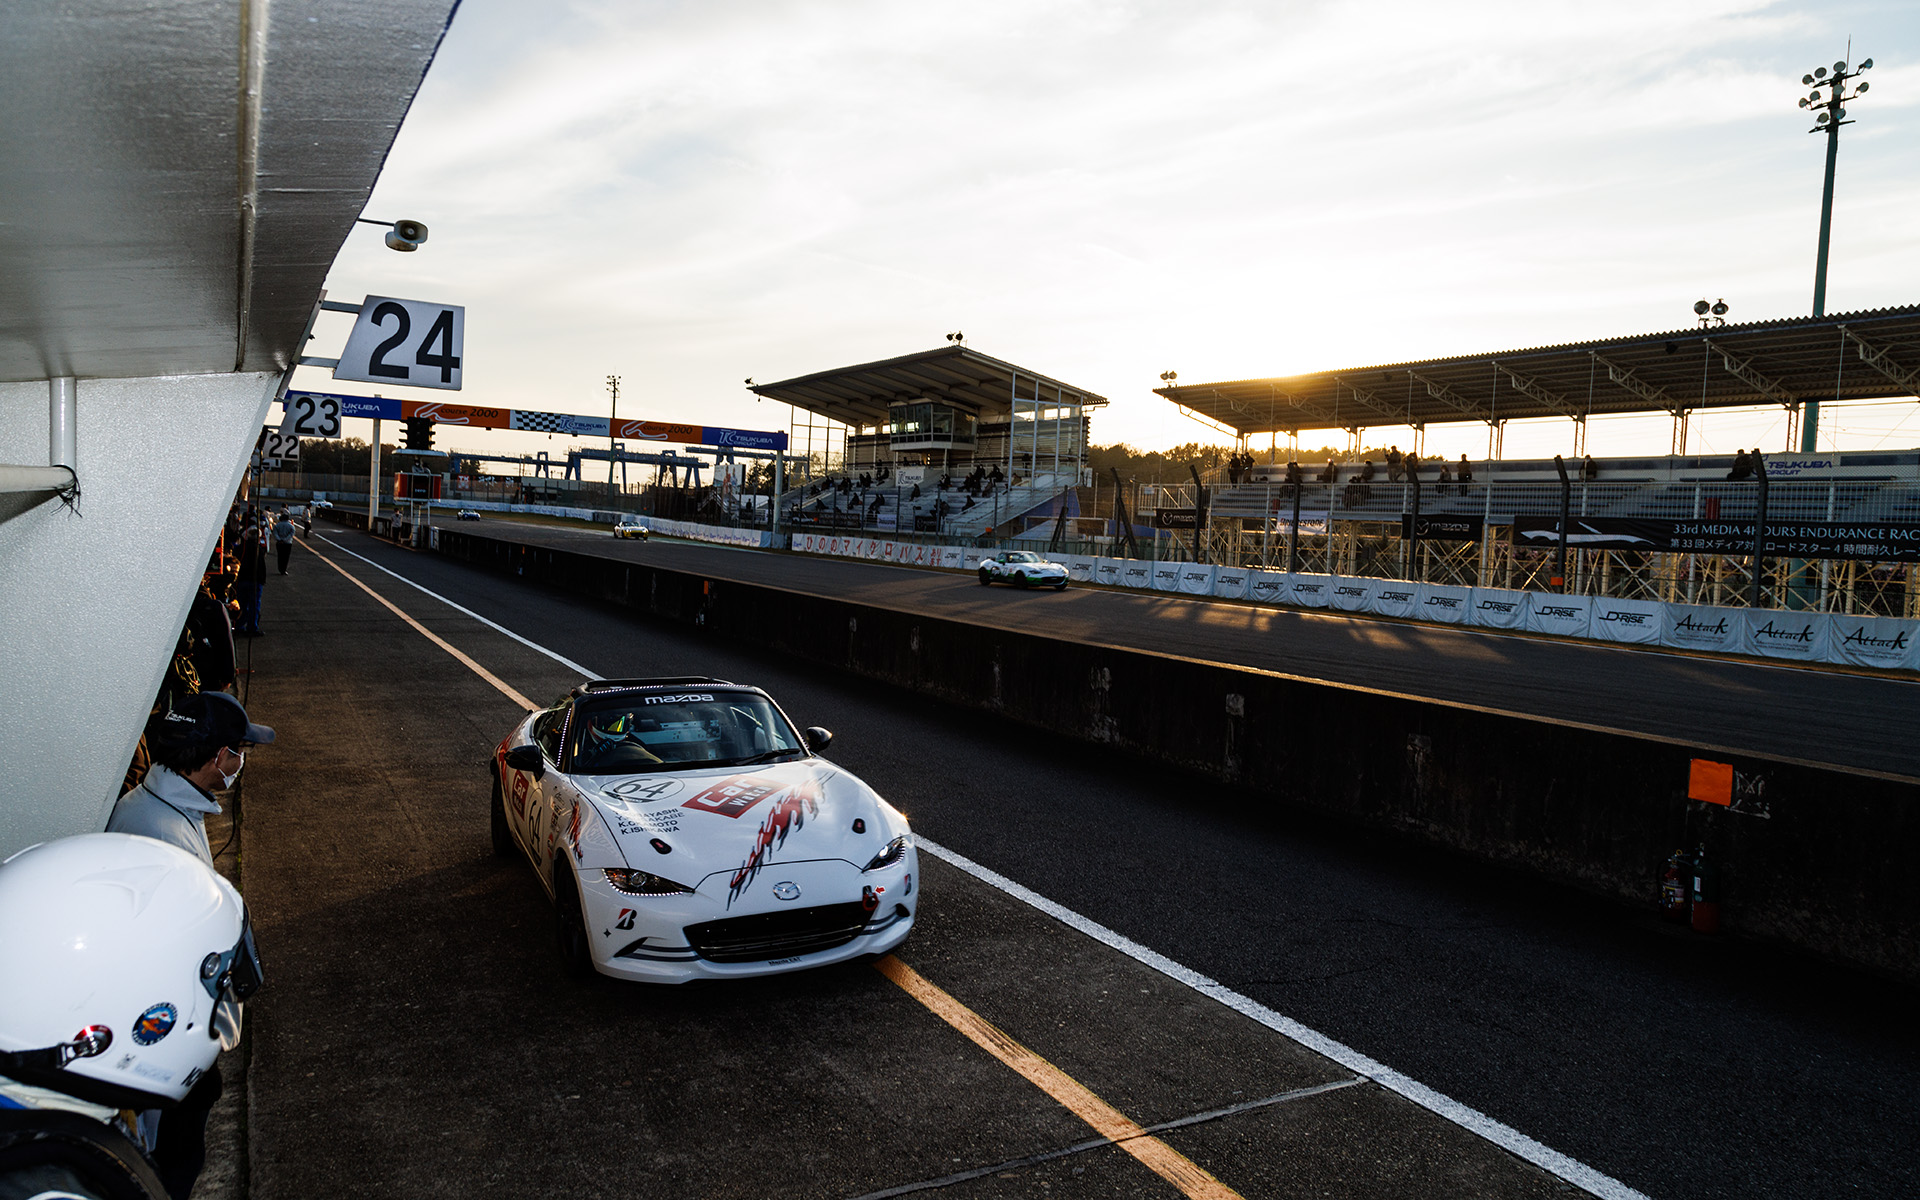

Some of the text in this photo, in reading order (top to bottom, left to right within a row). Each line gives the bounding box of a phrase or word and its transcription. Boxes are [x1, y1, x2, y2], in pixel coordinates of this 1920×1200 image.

[369, 301, 460, 383] 24
[295, 397, 339, 436] 23
[441, 407, 498, 418] course 2000
[668, 425, 693, 435] 2000
[269, 434, 298, 459] 22
[736, 435, 773, 444] TSUKUBA
[1768, 461, 1832, 469] TSUKUBA
[1673, 524, 1699, 534] 33rd
[1701, 524, 1740, 535] MEDIA
[1800, 526, 1886, 540] ENDURANCE
[1378, 591, 1414, 602] D-RISE
[1425, 596, 1462, 608] D-RISE
[1477, 601, 1517, 613] D-RISE
[1535, 606, 1582, 618] D-RISE
[1599, 611, 1652, 624] D-RISE
[1674, 614, 1728, 634] Attack
[1754, 620, 1814, 643] Attack
[1843, 626, 1908, 649] Attack
[644, 694, 715, 705] mazda
[614, 779, 674, 798] 64
[697, 780, 752, 807] Car
[729, 785, 772, 807] Watch
[529, 800, 541, 853] 64
